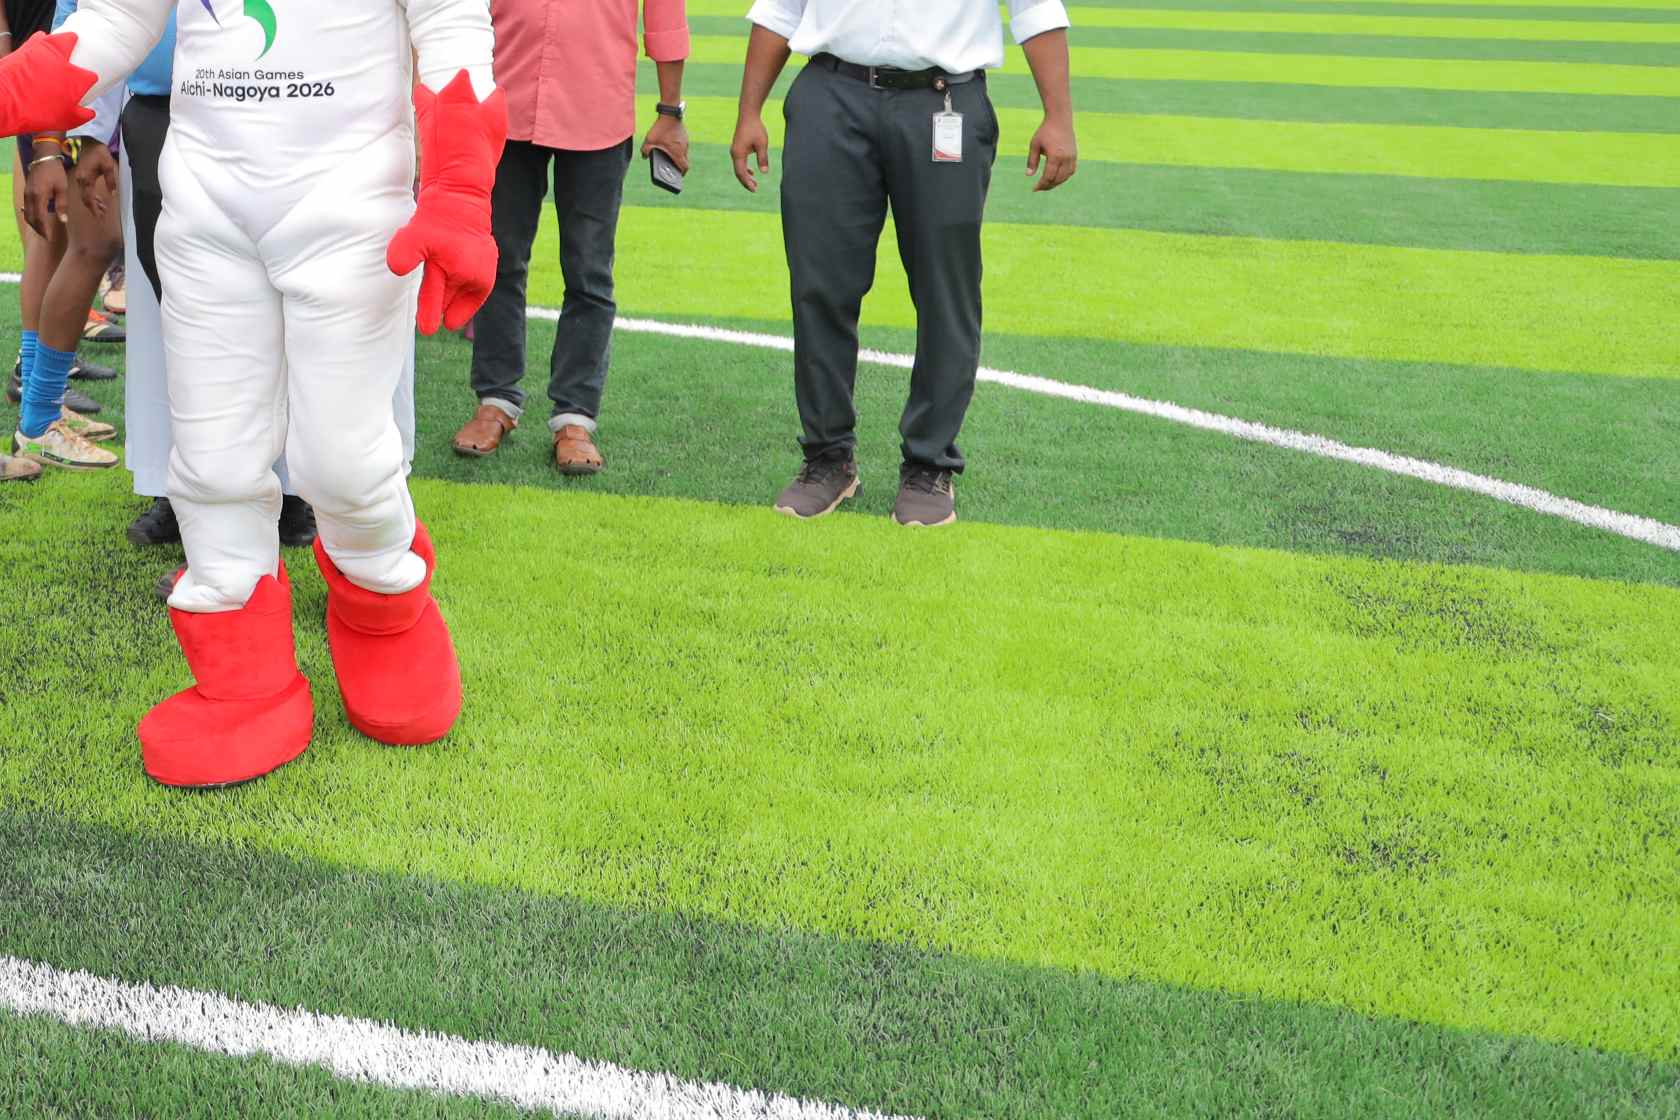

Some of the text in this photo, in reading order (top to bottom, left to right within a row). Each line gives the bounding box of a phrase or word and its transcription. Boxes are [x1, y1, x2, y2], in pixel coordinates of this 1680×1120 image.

[195, 68, 305, 80] 20th Asian Games
[180, 81, 335, 102] Aichi-Nagoya 2026
